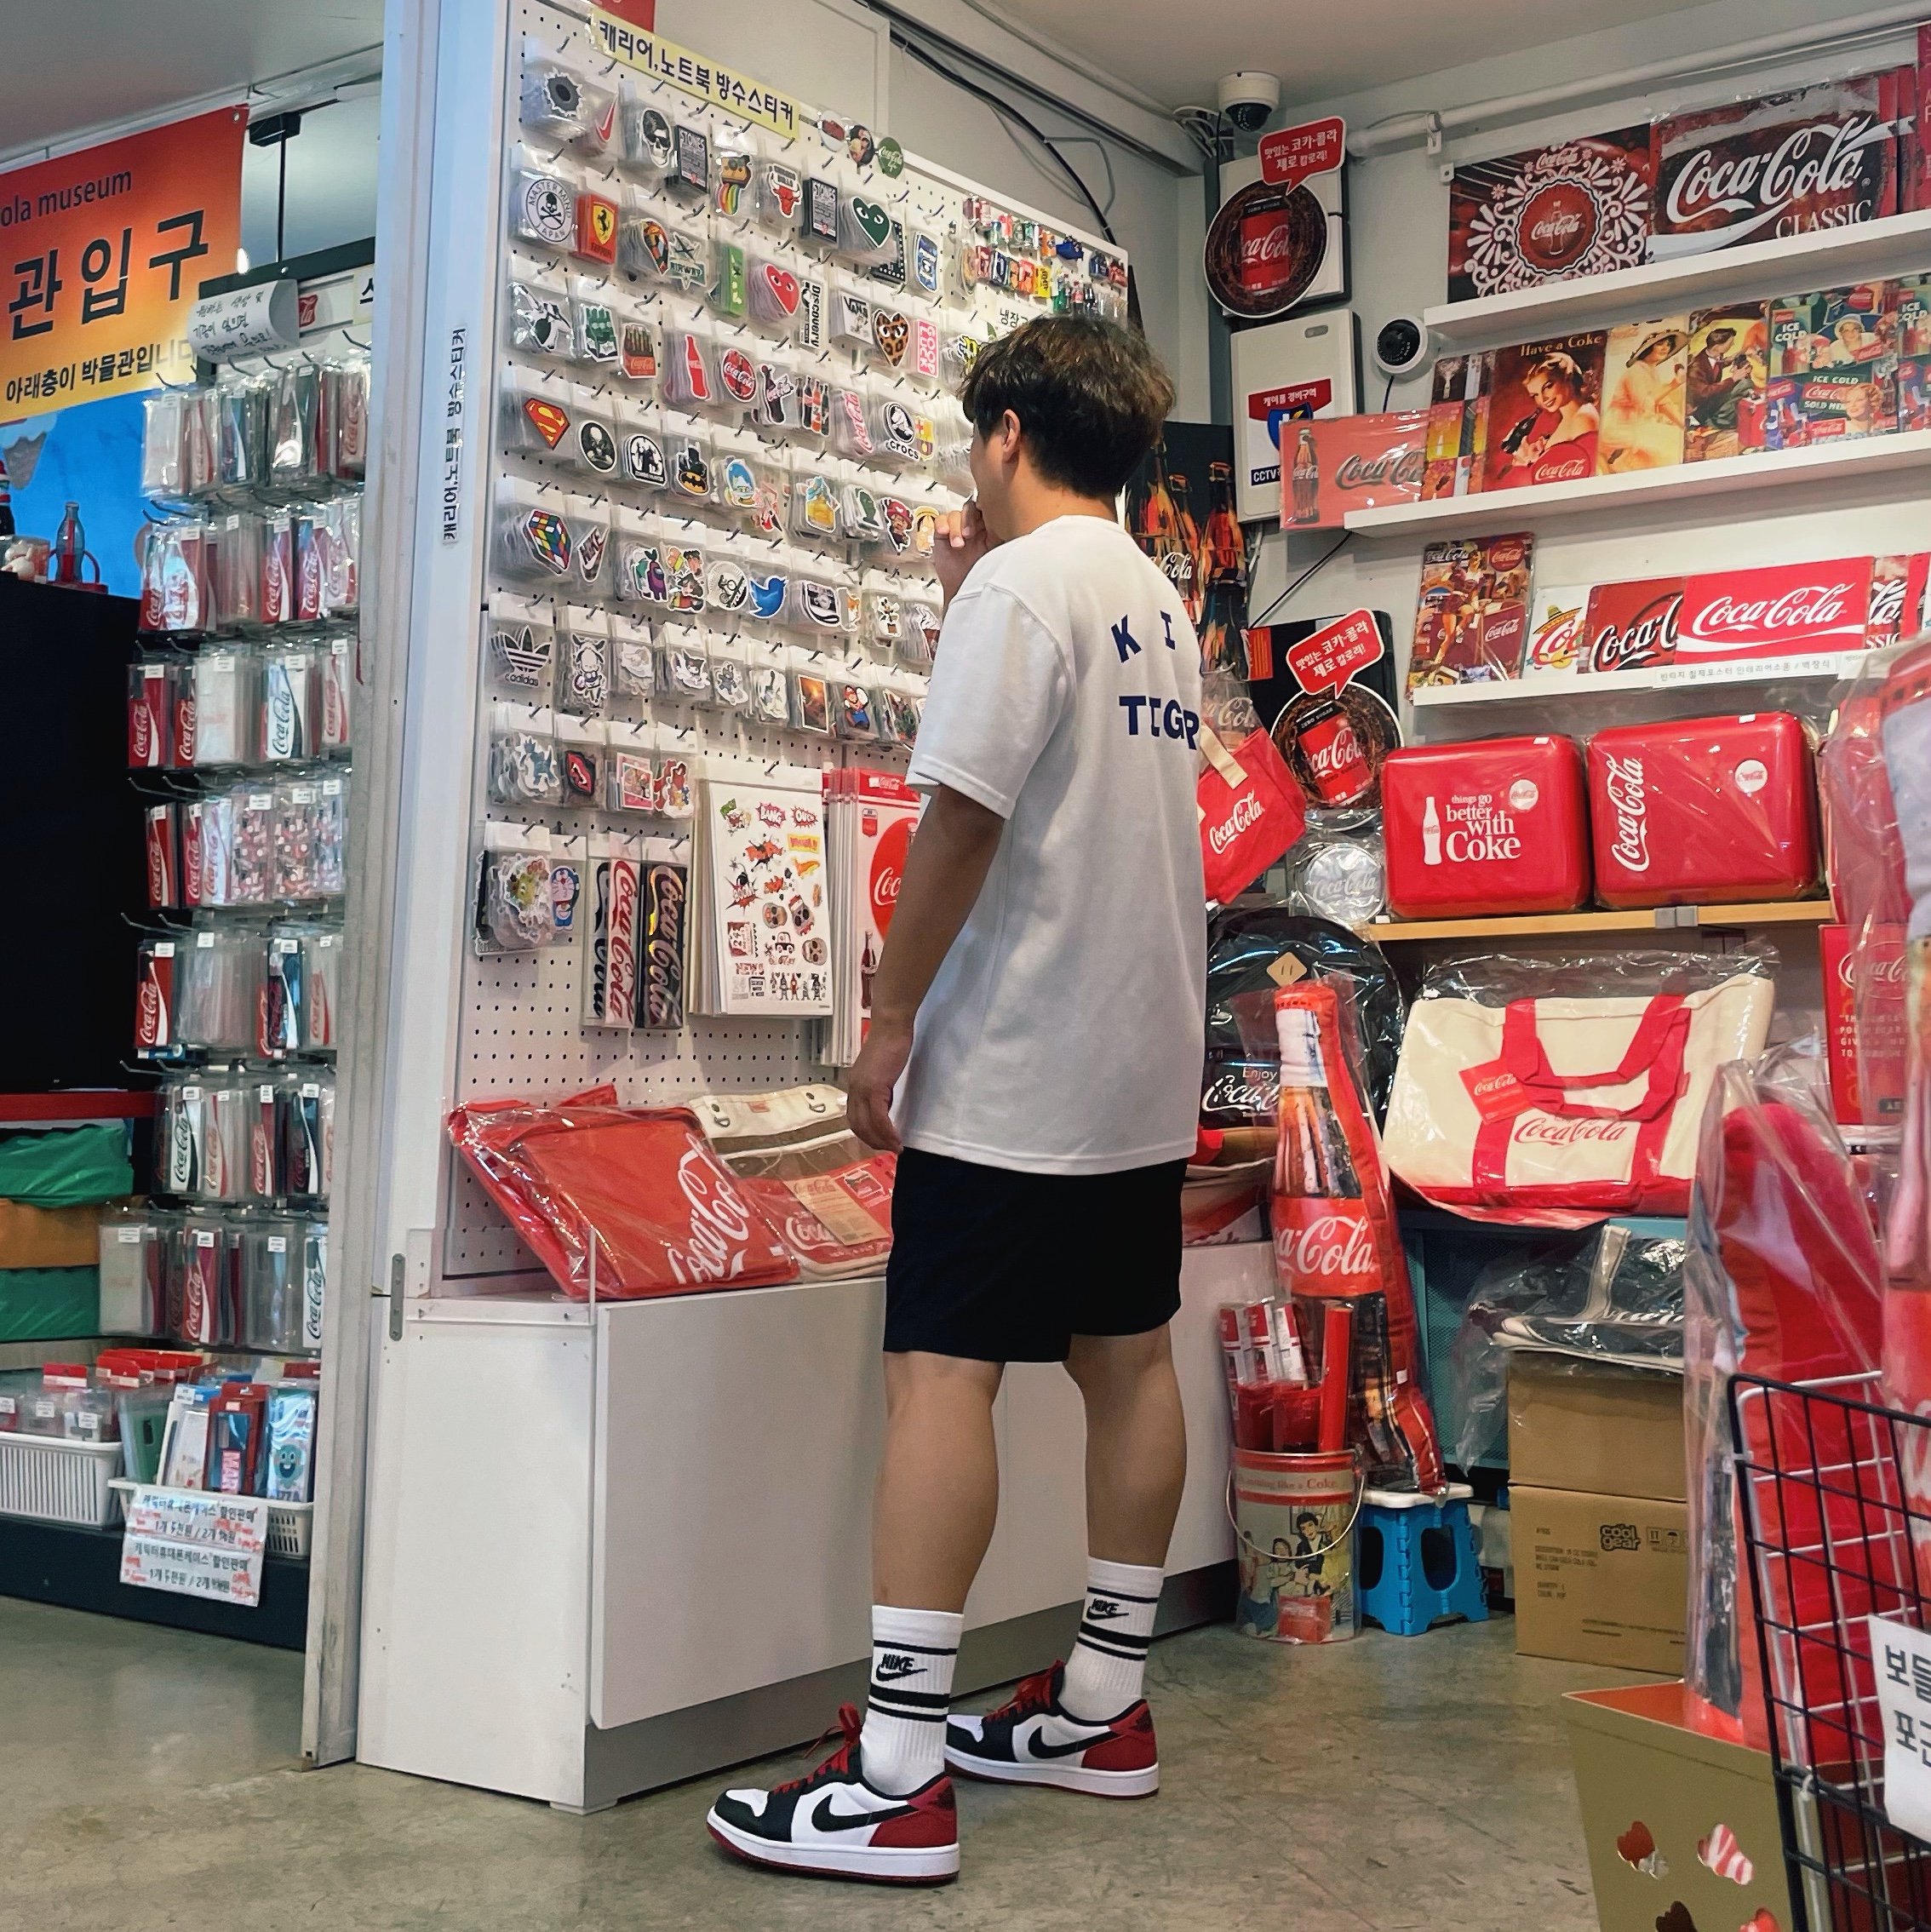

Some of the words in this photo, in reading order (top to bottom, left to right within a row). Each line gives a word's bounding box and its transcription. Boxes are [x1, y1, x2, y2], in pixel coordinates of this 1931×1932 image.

[599, 19, 711, 95] 캐리어,노트북
[716, 73, 797, 131] 방수스티커
[1292, 129, 1338, 151] 코카-콜라
[38, 170, 132, 217] museum
[1774, 200, 1871, 240] CLASSIC
[1775, 330, 1807, 342] COLD
[1782, 322, 1800, 332] ICE
[1520, 341, 1554, 358] Have
[1567, 334, 1603, 351] Coke
[6, 363, 76, 404] 아래층이
[448, 328, 467, 419] 방수스티커
[1813, 375, 1828, 384] ICE
[1831, 375, 1859, 385] COLD
[1803, 400, 1827, 410] SOLD
[889, 441, 920, 461] crocs
[1692, 582, 1857, 637] Coca-Cola
[1321, 620, 1369, 654] 코카-콜라
[1451, 794, 1477, 805] things
[1478, 793, 1493, 807] go
[1209, 789, 1265, 855] Coca-Cola
[1445, 804, 1493, 823] better
[1611, 749, 1651, 874] Coca-Cola
[1464, 814, 1516, 836] with
[1446, 831, 1521, 863] Coke
[1242, 1066, 1278, 1082] Enjoy
[1513, 1117, 1629, 1147] Coca-Cola
[1306, 1477, 1338, 1489] Coke
[1602, 1524, 1636, 1538] cool
[1602, 1535, 1640, 1551] gear
[1091, 1598, 1120, 1614] NIKE
[880, 1653, 916, 1672] NIKE
